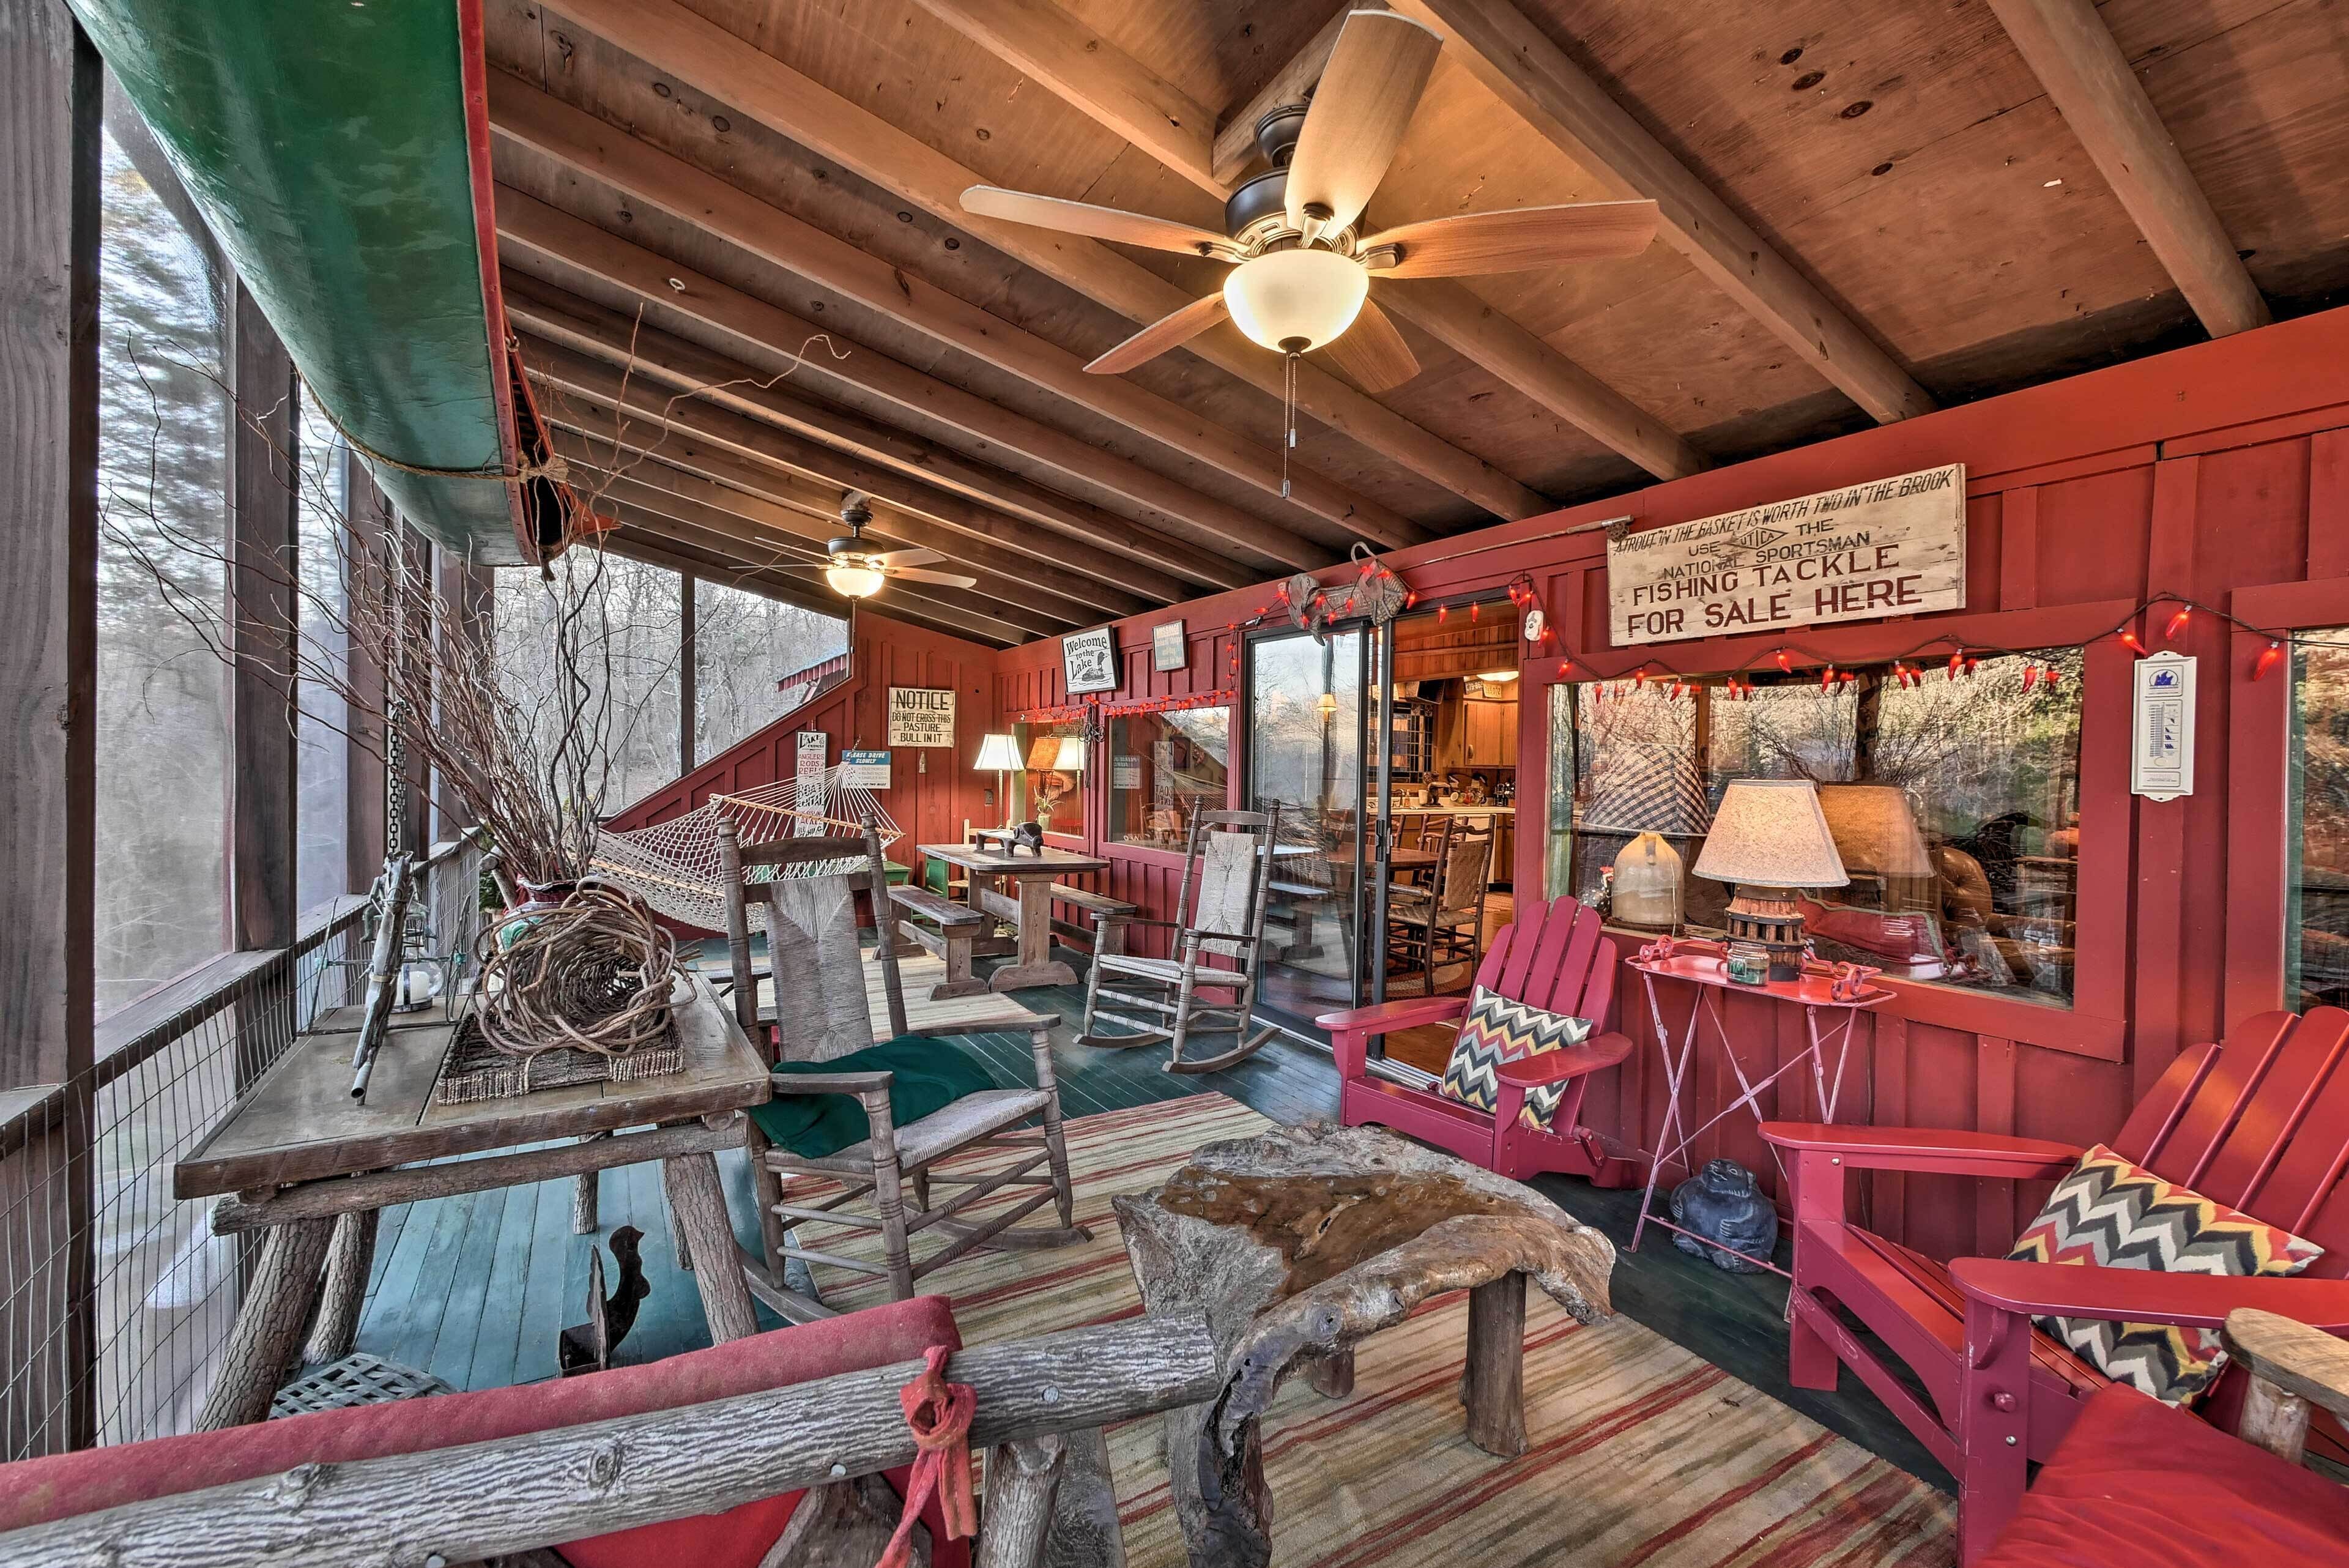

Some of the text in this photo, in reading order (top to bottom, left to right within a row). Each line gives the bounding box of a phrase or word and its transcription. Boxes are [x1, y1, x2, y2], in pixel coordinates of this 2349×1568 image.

[1622, 532, 1658, 554] TROUT
[1658, 529, 1672, 546] IN
[1674, 524, 1696, 543] THE
[1698, 514, 1746, 534] BASKET
[1746, 509, 1761, 527] IS
[1762, 499, 1809, 522] WORTH
[1814, 492, 1842, 515] TWO
[1842, 491, 1862, 507] IN
[1865, 481, 1898, 504] THE
[1898, 469, 1954, 497] BROOK
[1688, 519, 1834, 556] USE UTICA THE
[1663, 531, 1870, 579] NATIONAL SPORTSMAN
[1633, 544, 1900, 606] FISHING TACKLE
[1628, 574, 1923, 638] FOR SALE HERE
[1066, 637, 1107, 655] Welcome
[1070, 659, 1092, 681] Lake
[896, 690, 949, 710] NOTICE
[892, 712, 951, 723] DO NOT CROSS THIS
[904, 723, 941, 732] PASTURE
[900, 733, 942, 743] BULL IN IT
[797, 783, 822, 798] BOAT
